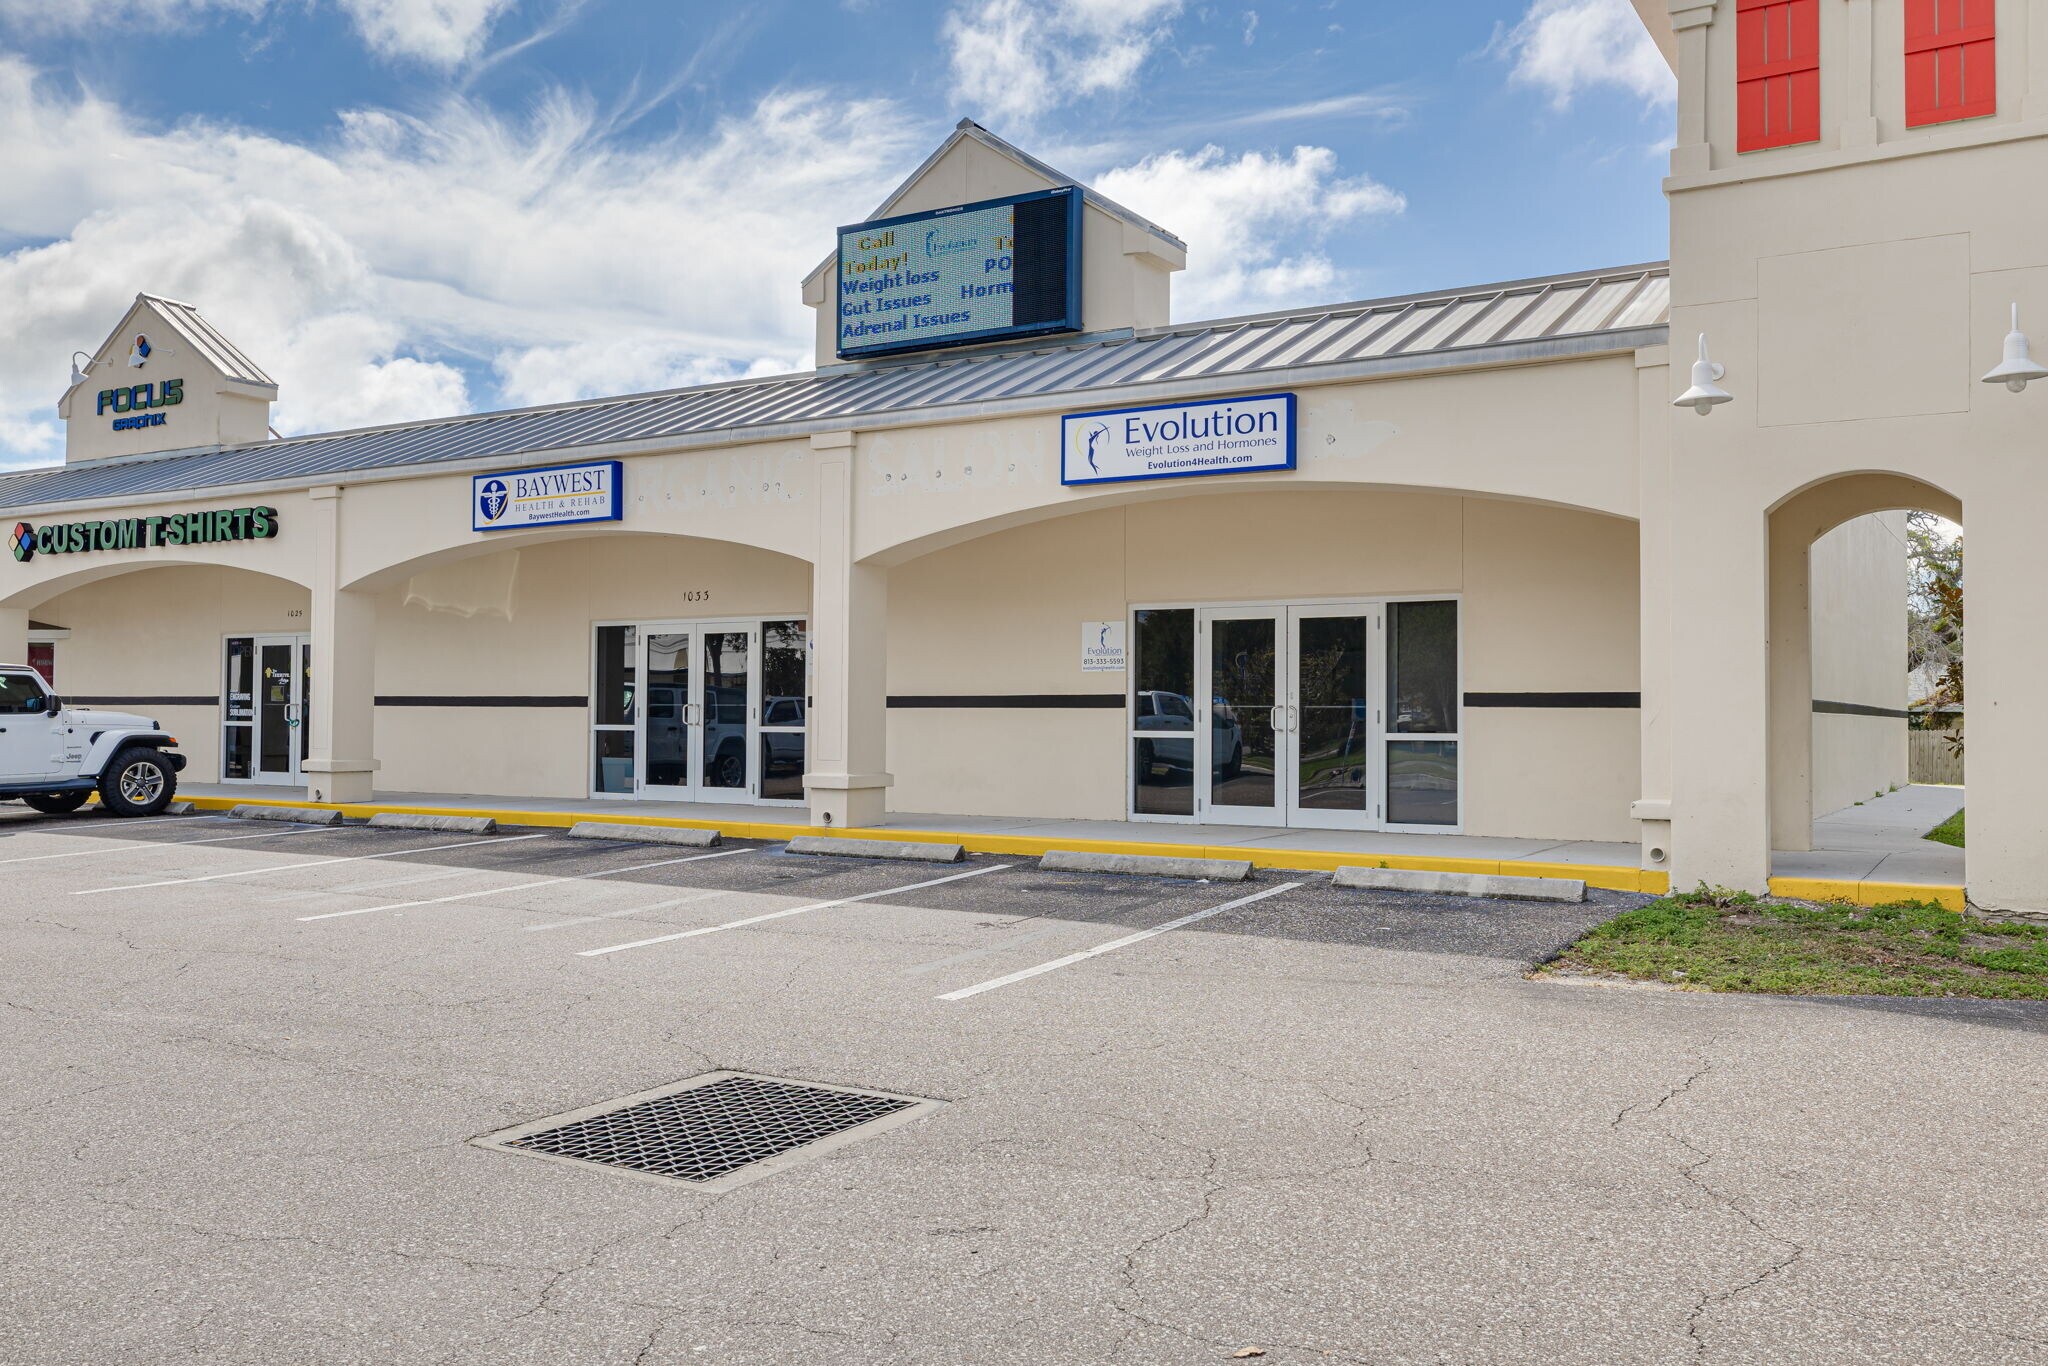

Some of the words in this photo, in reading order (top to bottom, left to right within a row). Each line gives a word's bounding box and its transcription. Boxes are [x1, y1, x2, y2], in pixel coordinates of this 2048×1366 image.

[858, 231, 894, 250] Call
[844, 252, 907, 275] Today!
[842, 273, 902, 295] Weight
[905, 269, 940, 285] loss
[842, 299, 871, 316] Gut
[876, 294, 931, 312] Issues
[843, 314, 907, 338] Adrenal
[913, 310, 970, 329] Issues
[97, 378, 184, 416] FOCUS
[1125, 407, 1278, 445] Evolution
[1125, 445, 1164, 458] Weight
[1167, 443, 1190, 454] Loss
[1192, 440, 1214, 452] and
[1217, 436, 1277, 450] Hormones
[1147, 453, 1253, 470] Evolution4Health.com
[516, 469, 605, 498] BAYWEST
[514, 499, 554, 512] HEALTH
[559, 499, 565, 508] &
[570, 495, 606, 508] REHAB
[528, 509, 590, 521] BaywestHealth.com
[37, 518, 146, 555] CUSTOM
[146, 506, 278, 547] T-SHIRTS
[683, 590, 709, 602] 1033
[1087, 647, 1122, 655] Evolution
